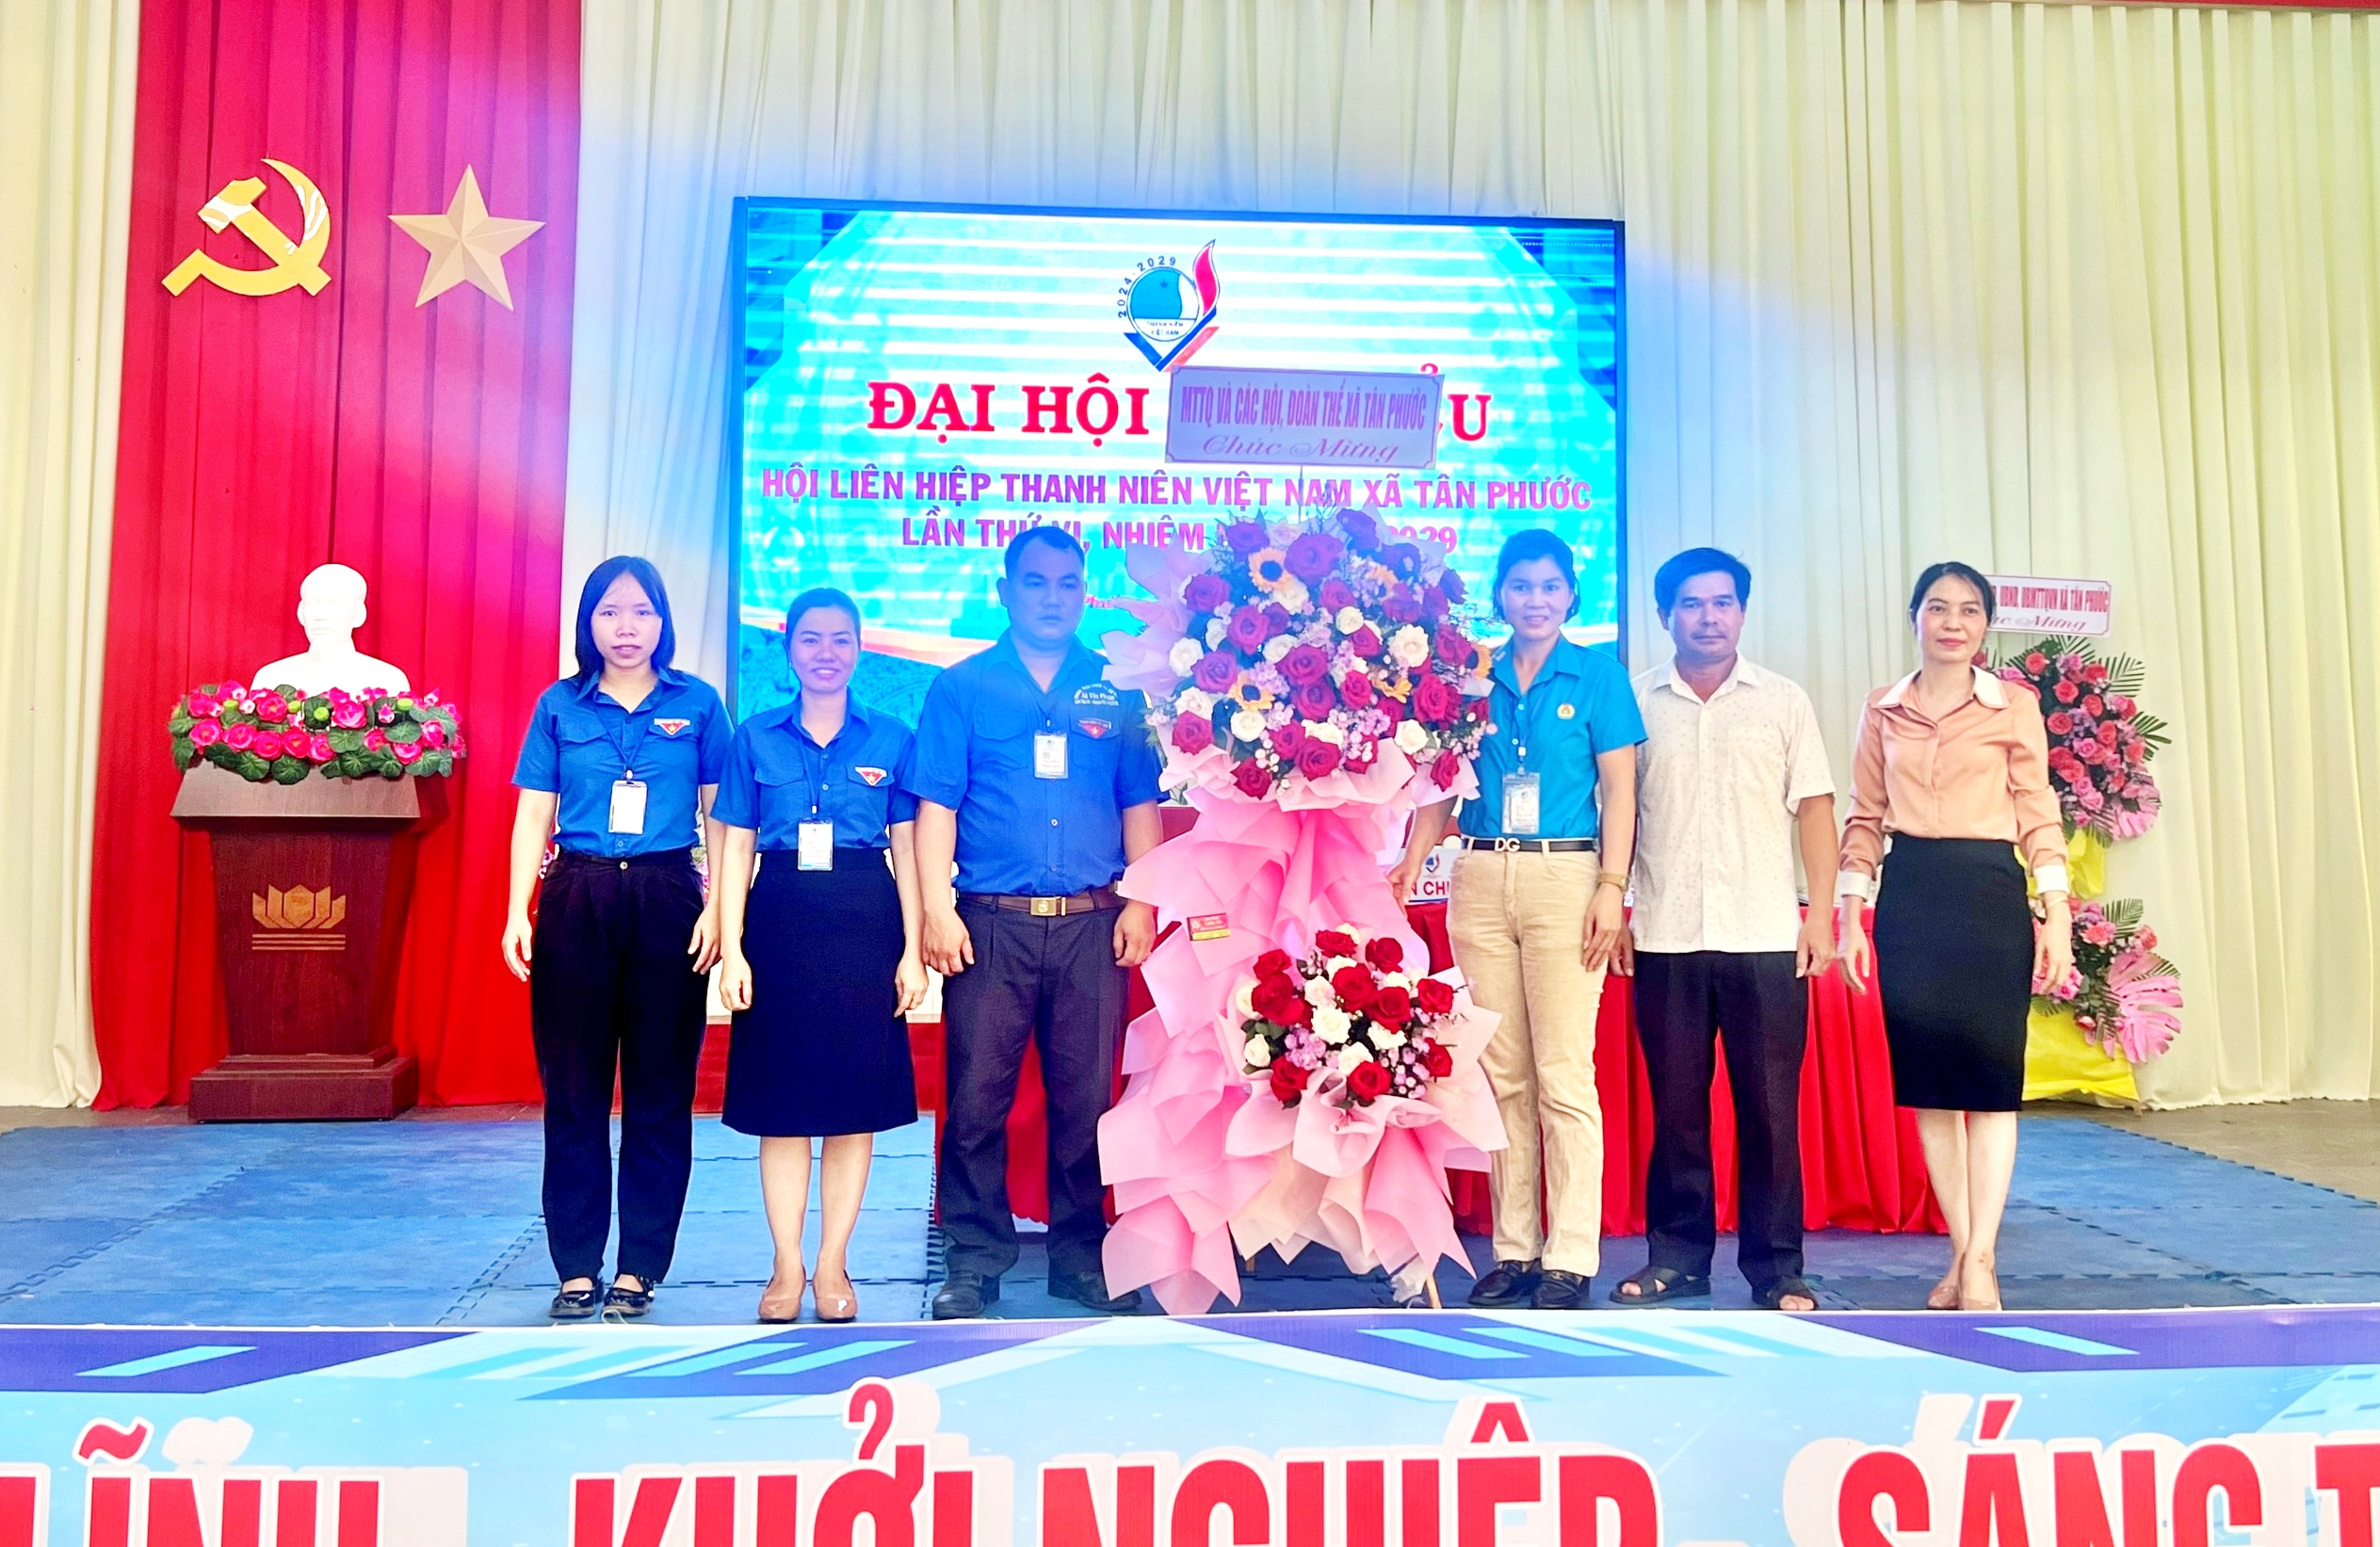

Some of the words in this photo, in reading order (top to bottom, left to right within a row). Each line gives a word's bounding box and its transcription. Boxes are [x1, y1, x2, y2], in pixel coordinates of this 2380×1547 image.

[867, 381, 995, 443] ĐẠI
[1021, 372, 1149, 447] HỘI
[1180, 385, 1214, 427] MTTQ
[1217, 380, 1232, 425] VÀ
[1235, 380, 1259, 426] CÁC
[1363, 385, 1386, 429] TÂN
[1203, 434, 1282, 456] Chúc
[1289, 438, 1400, 463] Mừng
[763, 461, 818, 503] HỘI
[830, 463, 903, 500] LIÊN
[915, 465, 992, 507] HIỆP
[1000, 474, 1106, 504] THANH
[1119, 469, 1191, 505] NIÊN
[1203, 471, 1272, 511] VIỆT
[1285, 478, 1352, 507] NAM
[1364, 473, 1402, 508] XÃ
[1414, 473, 1475, 509] TÂN
[1487, 475, 1591, 509] PHƯỚC
[902, 506, 965, 546] LẦN
[1495, 837, 1520, 852] DG
